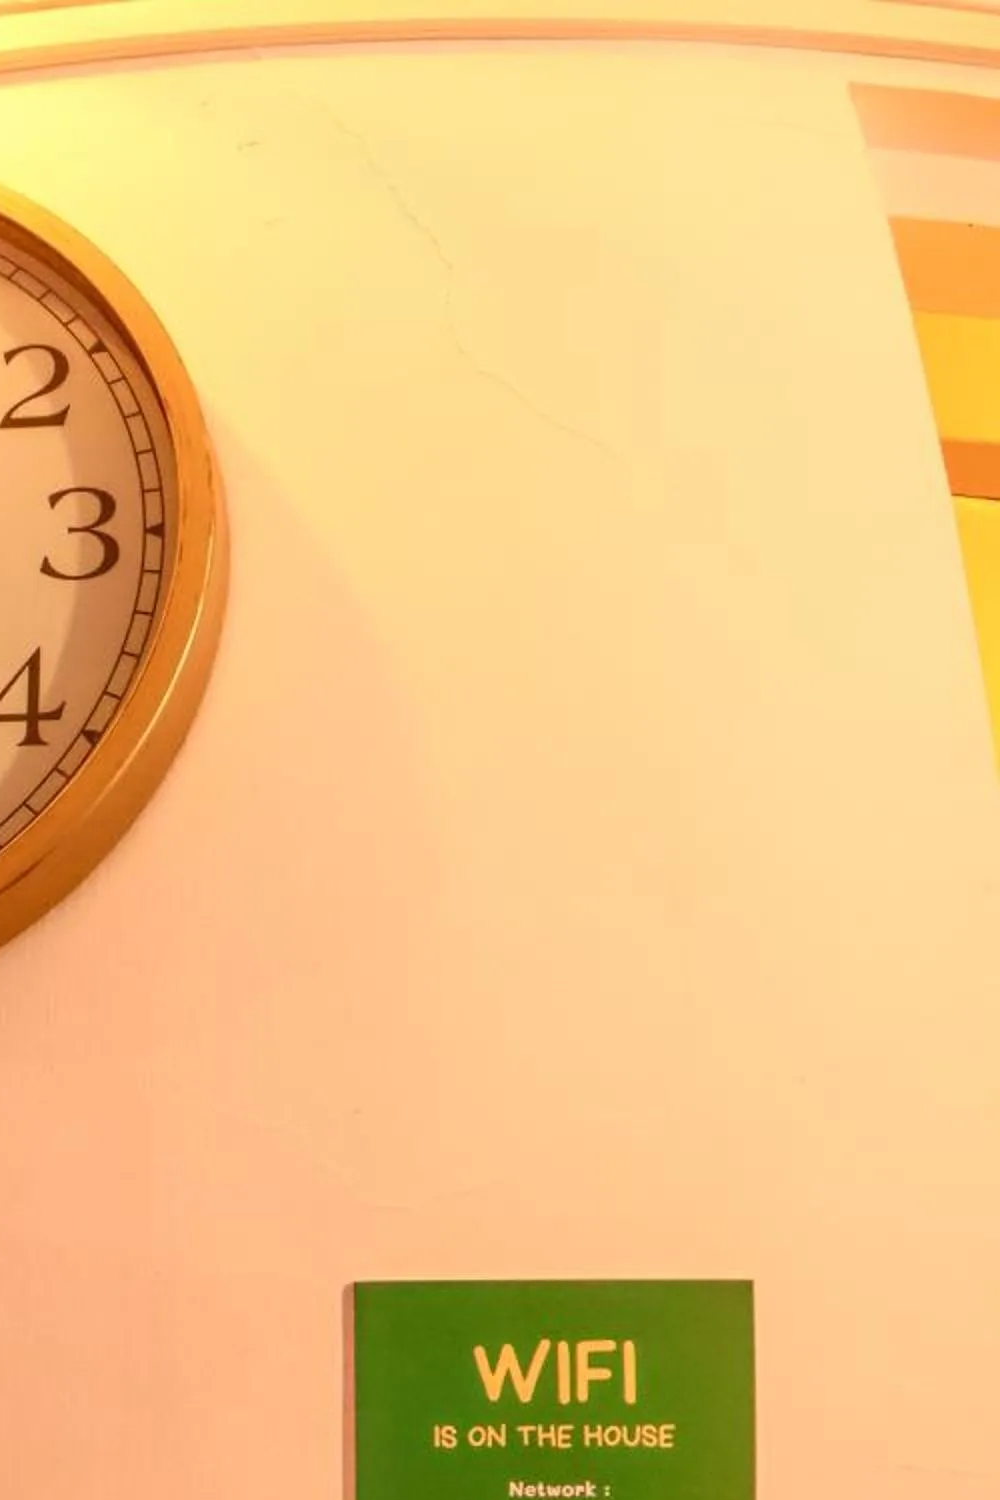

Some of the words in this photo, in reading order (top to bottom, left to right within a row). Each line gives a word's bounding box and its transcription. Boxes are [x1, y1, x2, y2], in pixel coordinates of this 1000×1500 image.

[39, 487, 120, 580] 3
[472, 1338, 637, 1405] WIFI
[433, 1425, 458, 1449] IS
[468, 1424, 507, 1449] ON
[517, 1425, 573, 1449] THE
[583, 1424, 676, 1449] HOUSE
[508, 1480, 597, 1499] Network
